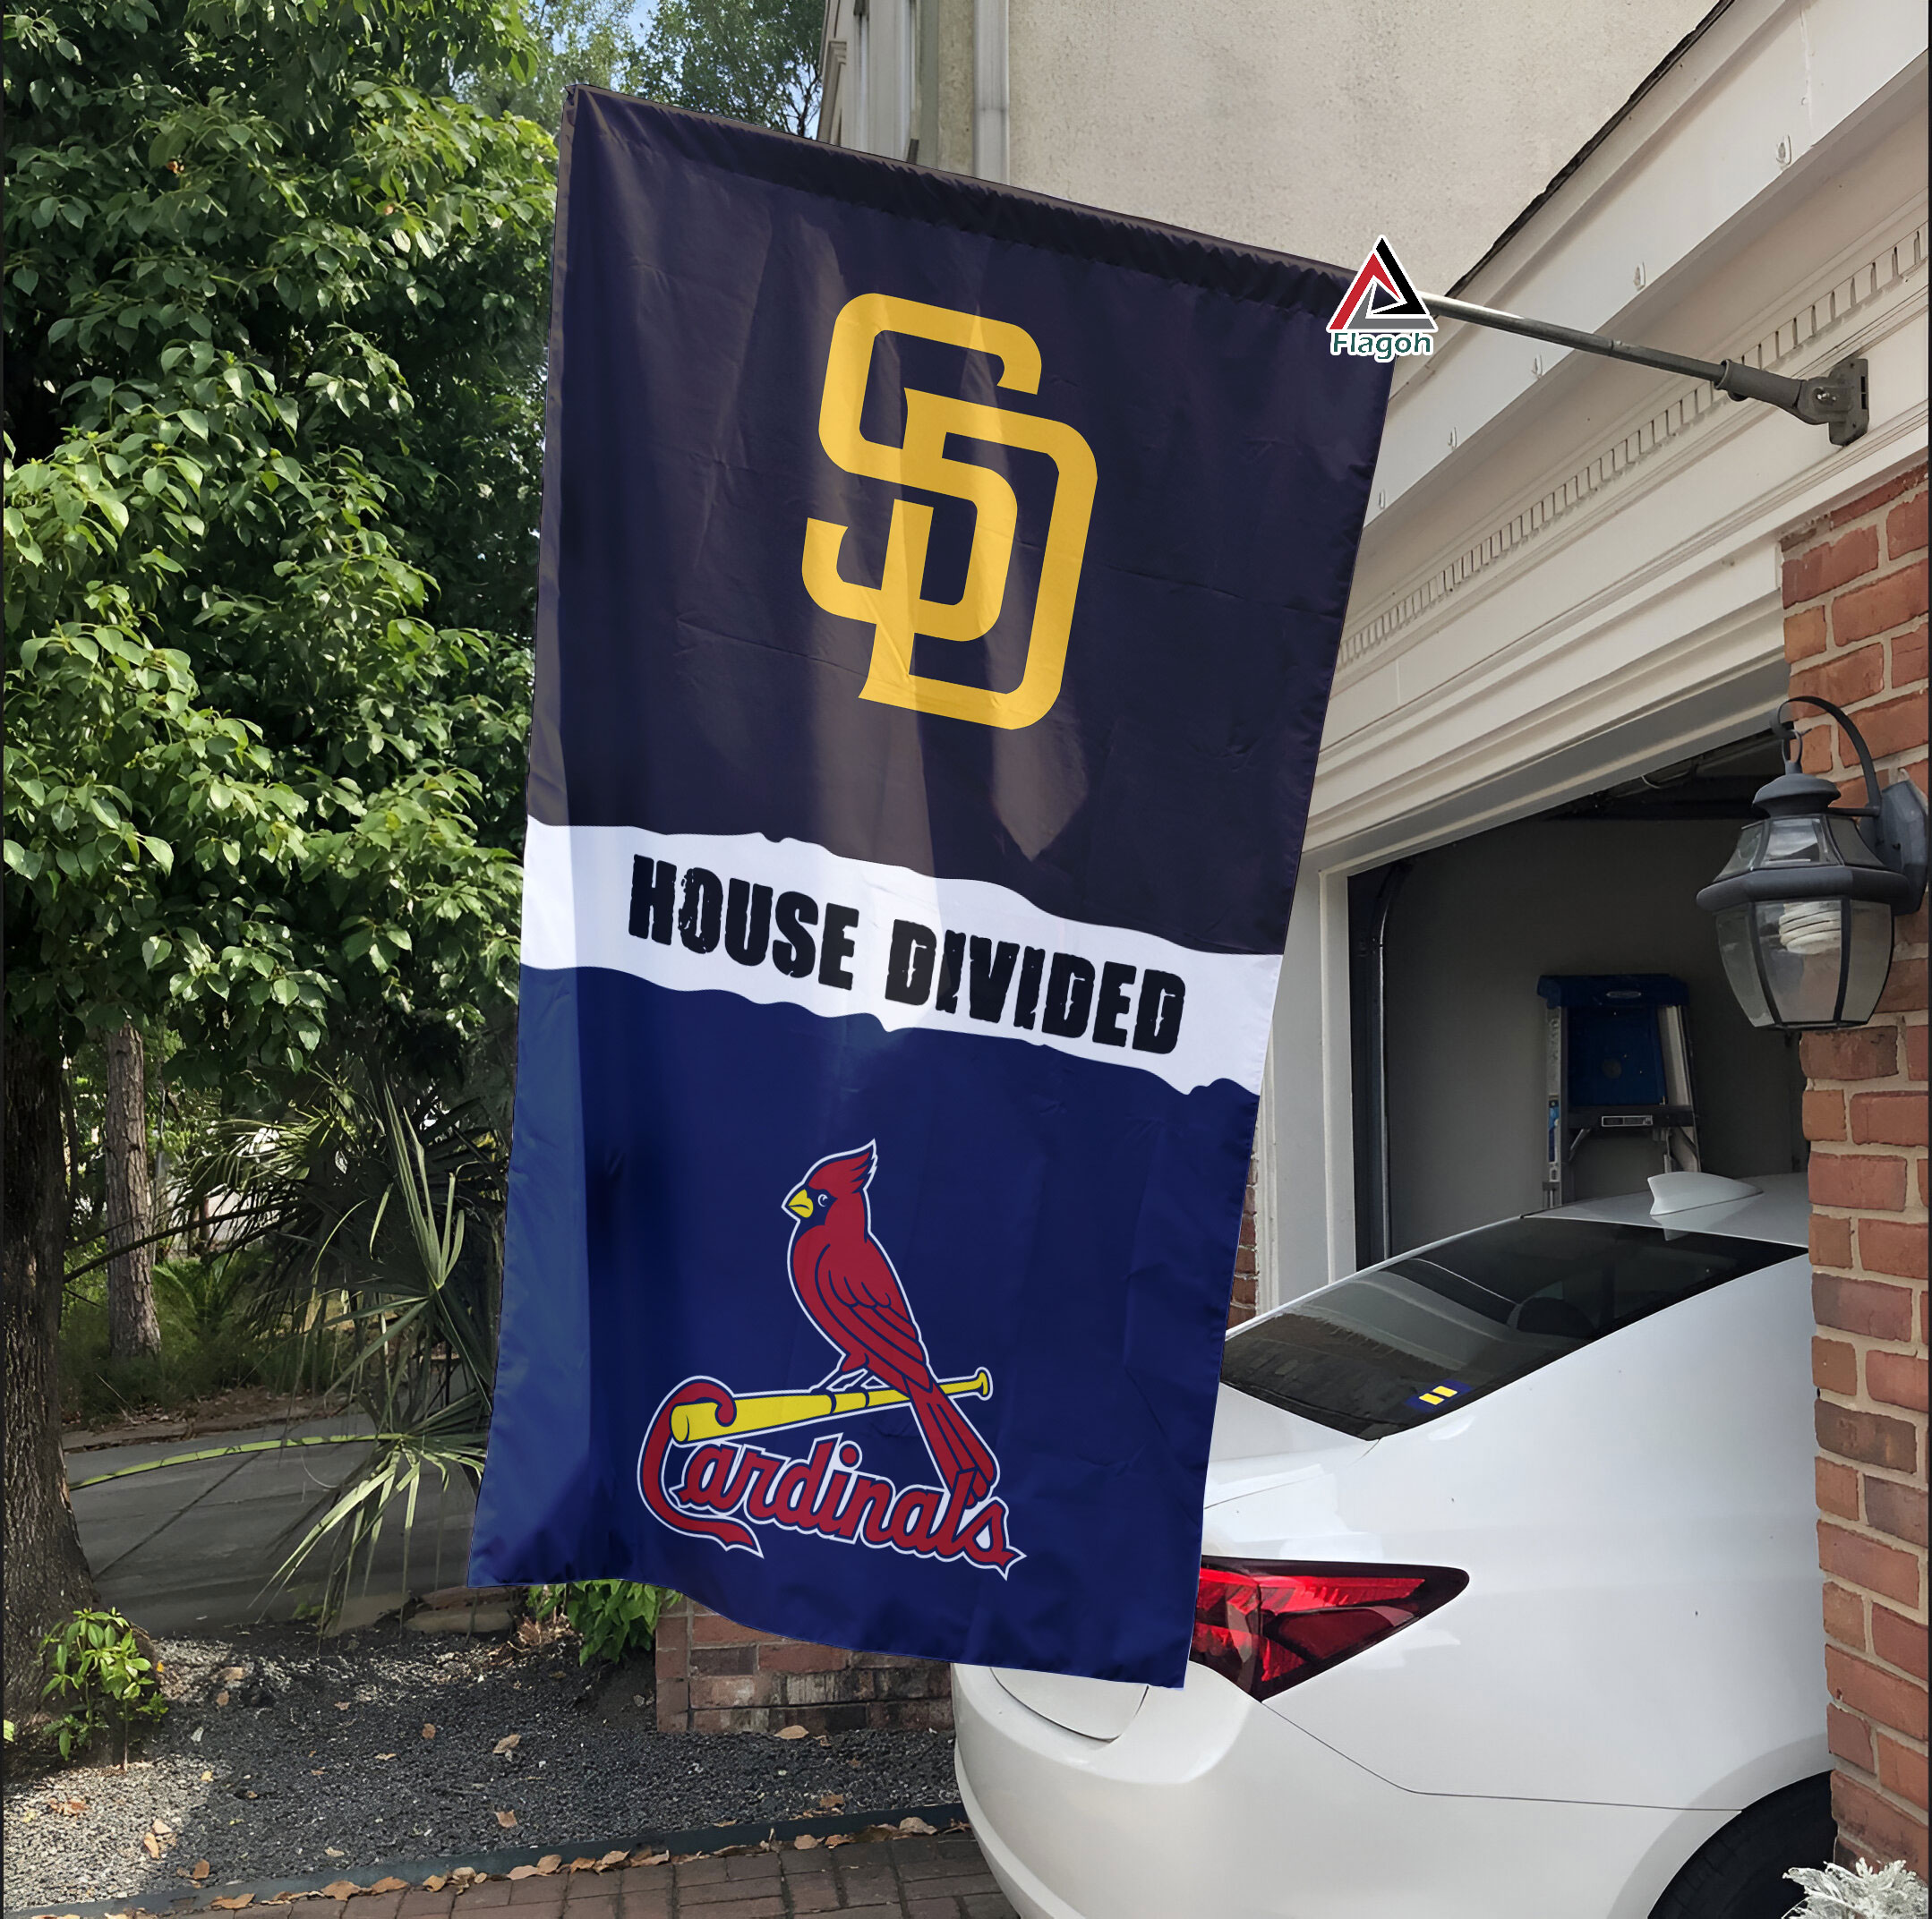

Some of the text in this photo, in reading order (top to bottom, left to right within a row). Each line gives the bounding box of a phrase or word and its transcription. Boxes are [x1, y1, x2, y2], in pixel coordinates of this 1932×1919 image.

[802, 293, 1098, 729] SD
[628, 854, 1186, 1055] HOUSE DIVIDED
[637, 1376, 1027, 1581] Cardinals
